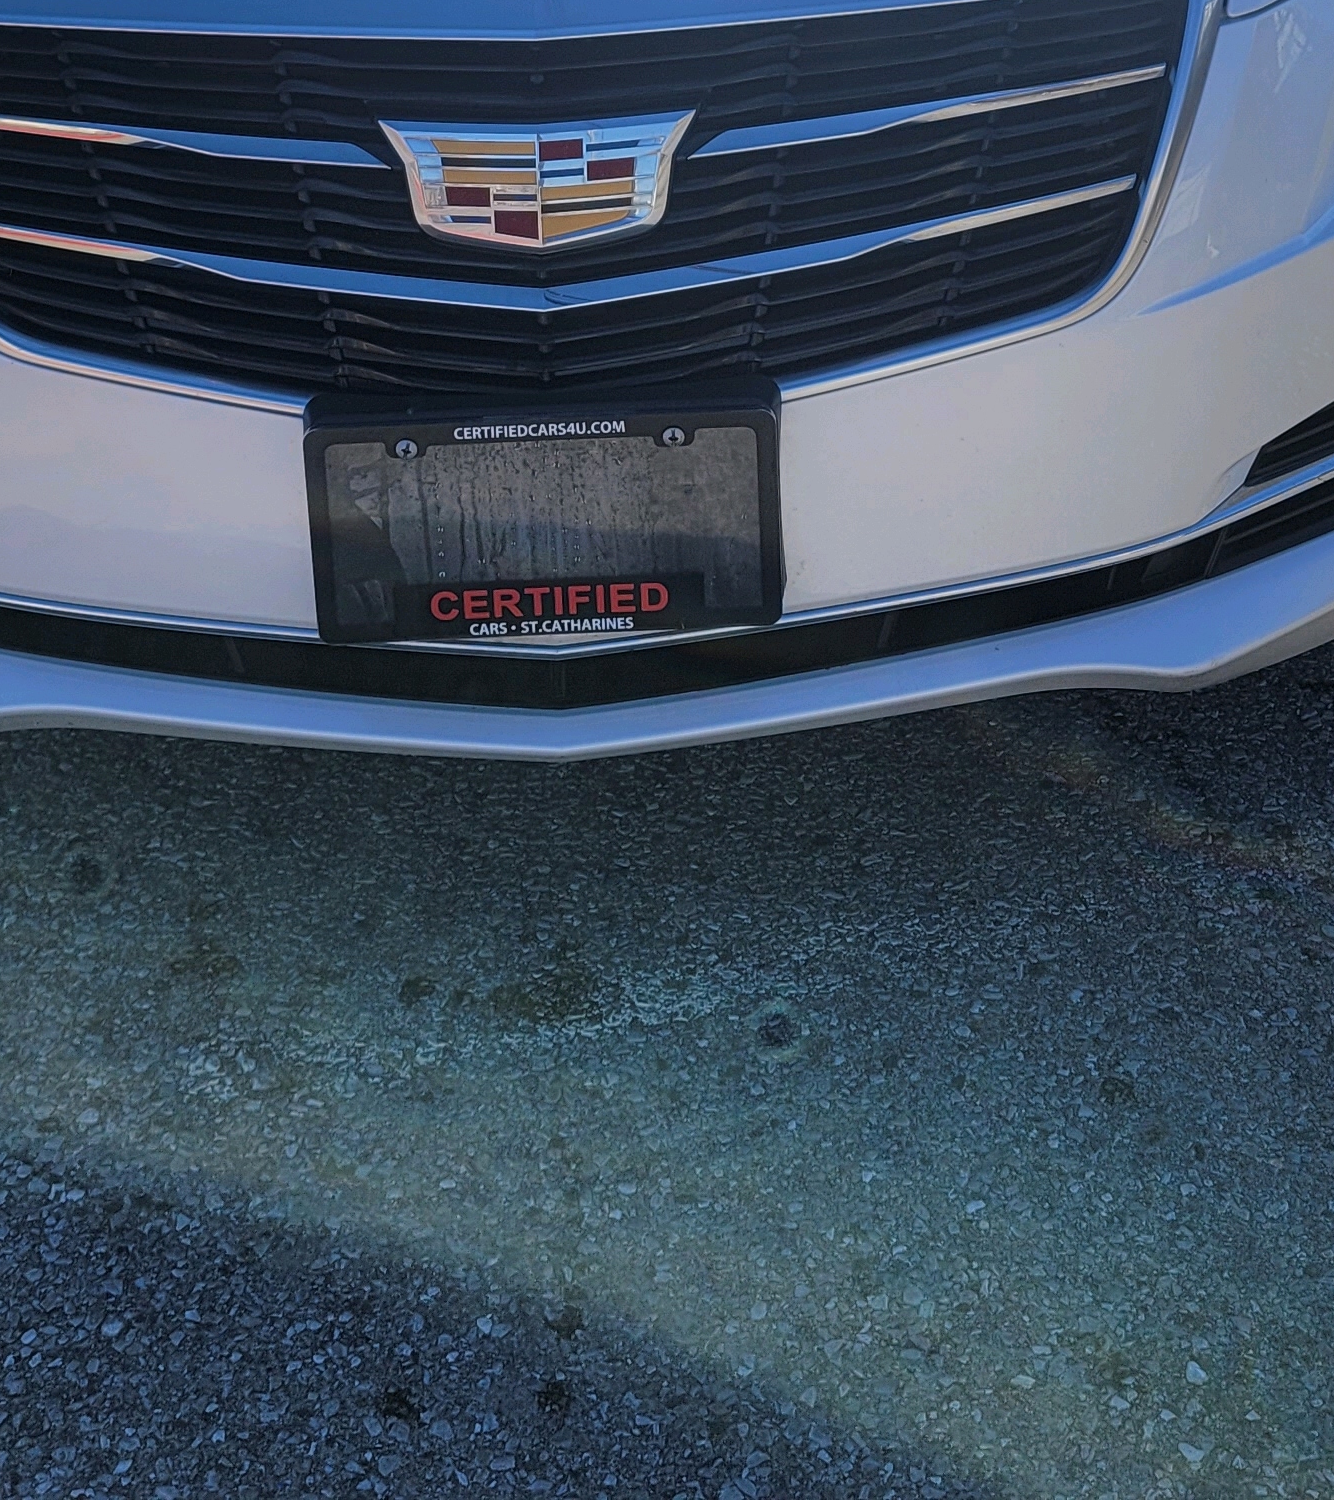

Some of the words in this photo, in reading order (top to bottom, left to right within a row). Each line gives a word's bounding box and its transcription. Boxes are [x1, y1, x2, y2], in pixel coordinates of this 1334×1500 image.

[453, 420, 626, 441] CERTIFIEDCARS4U.COM
[430, 582, 669, 621] CERTIFIED
[469, 621, 508, 636] CARS
[520, 616, 635, 634] ST.CATHARINES
